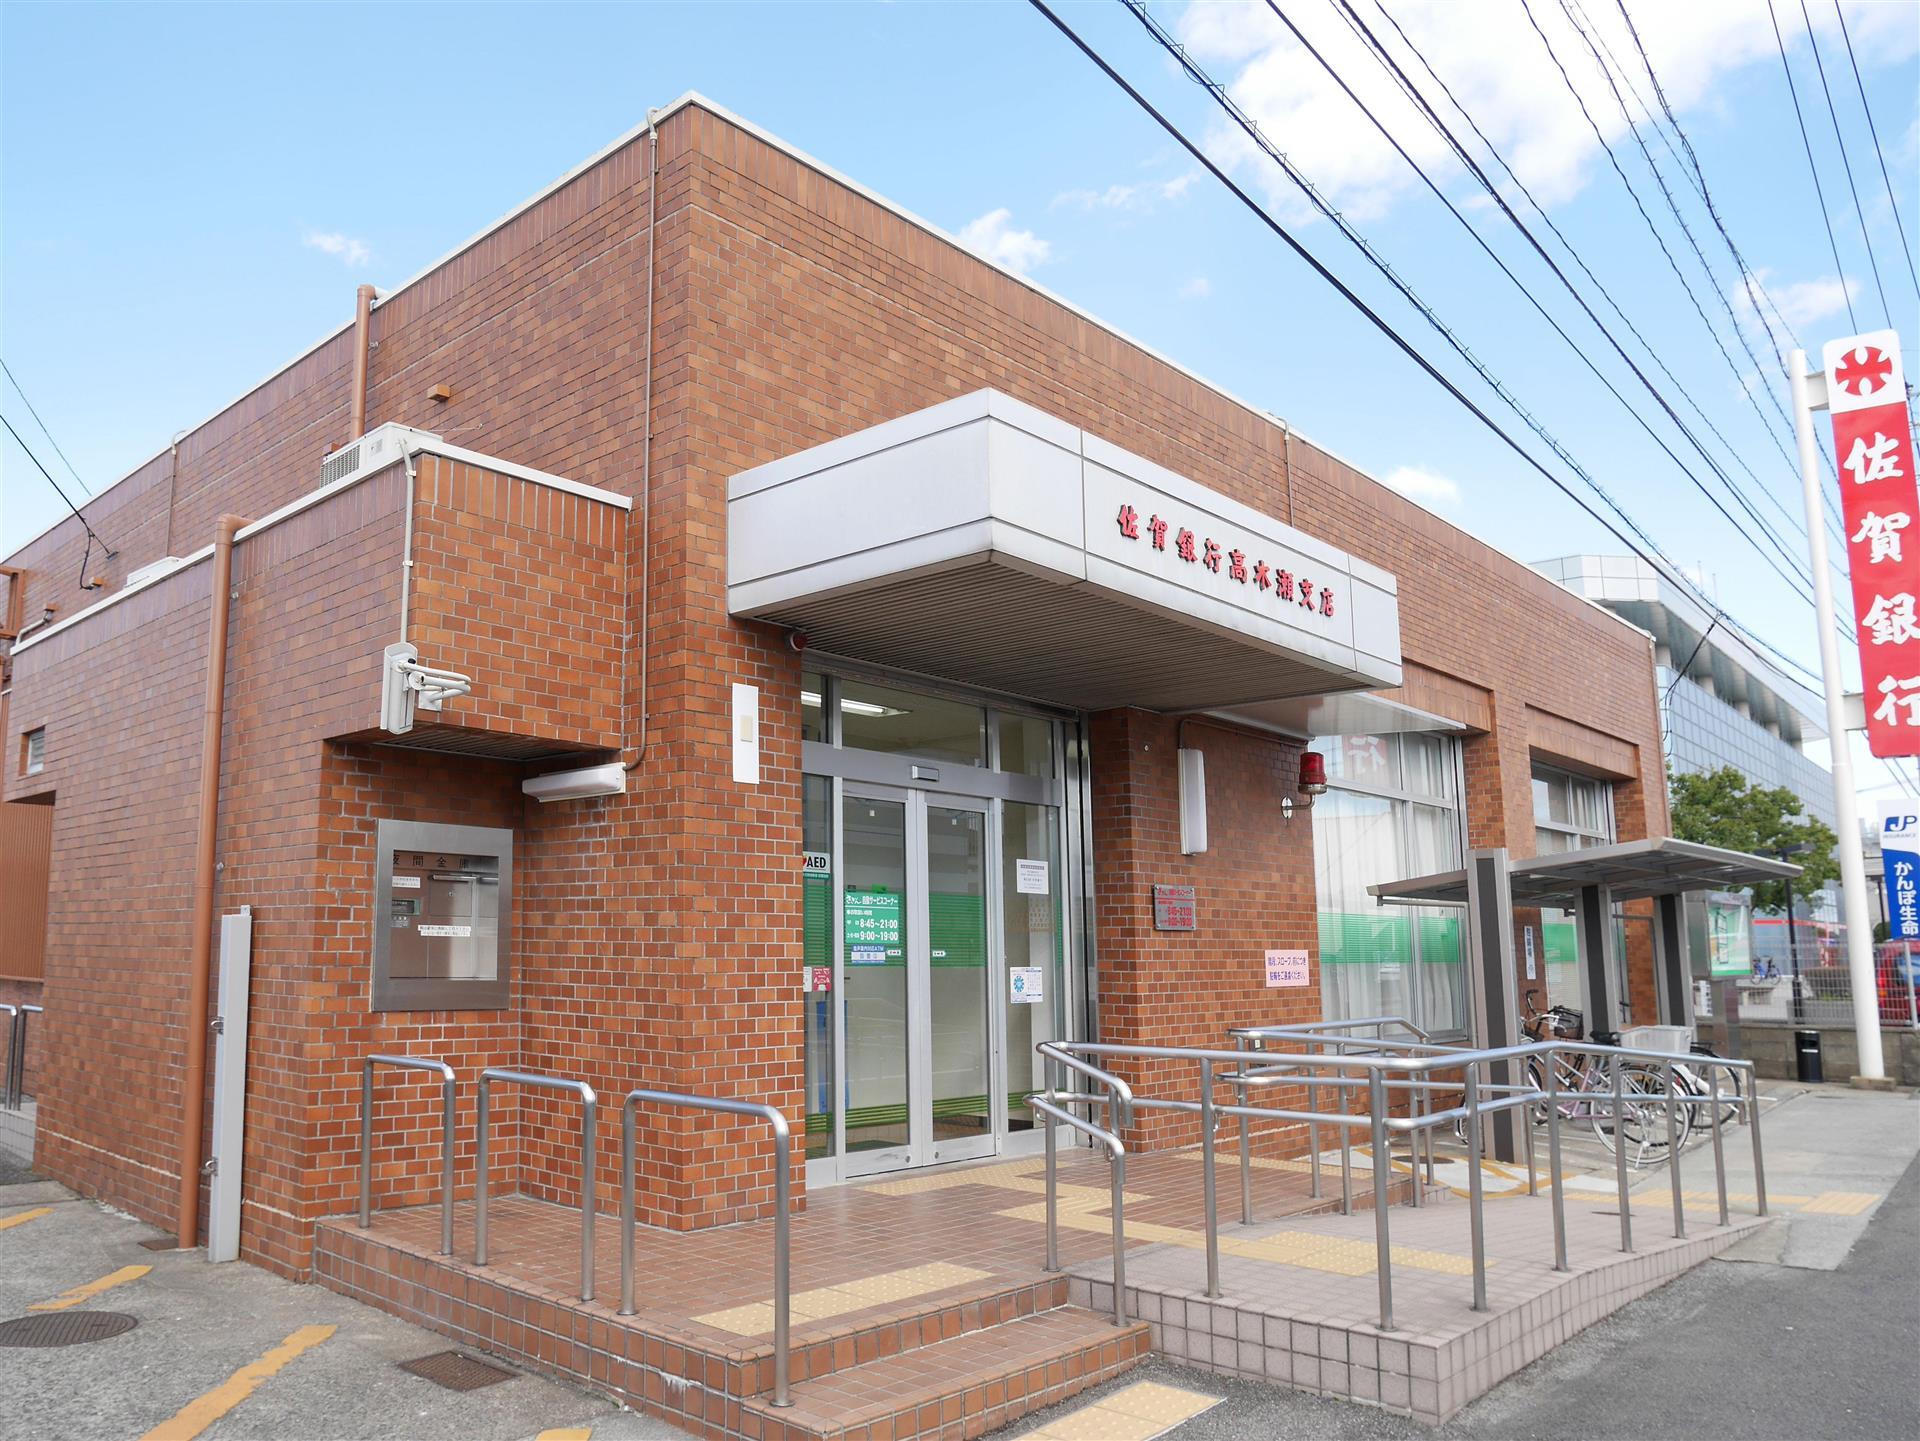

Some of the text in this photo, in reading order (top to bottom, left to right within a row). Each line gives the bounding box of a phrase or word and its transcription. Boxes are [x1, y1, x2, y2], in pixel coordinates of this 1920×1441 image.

[1843, 432, 1920, 727] 佐賀銀行
[806, 856, 827, 869] AED
[1894, 861, 1919, 936] かんぽ生命
